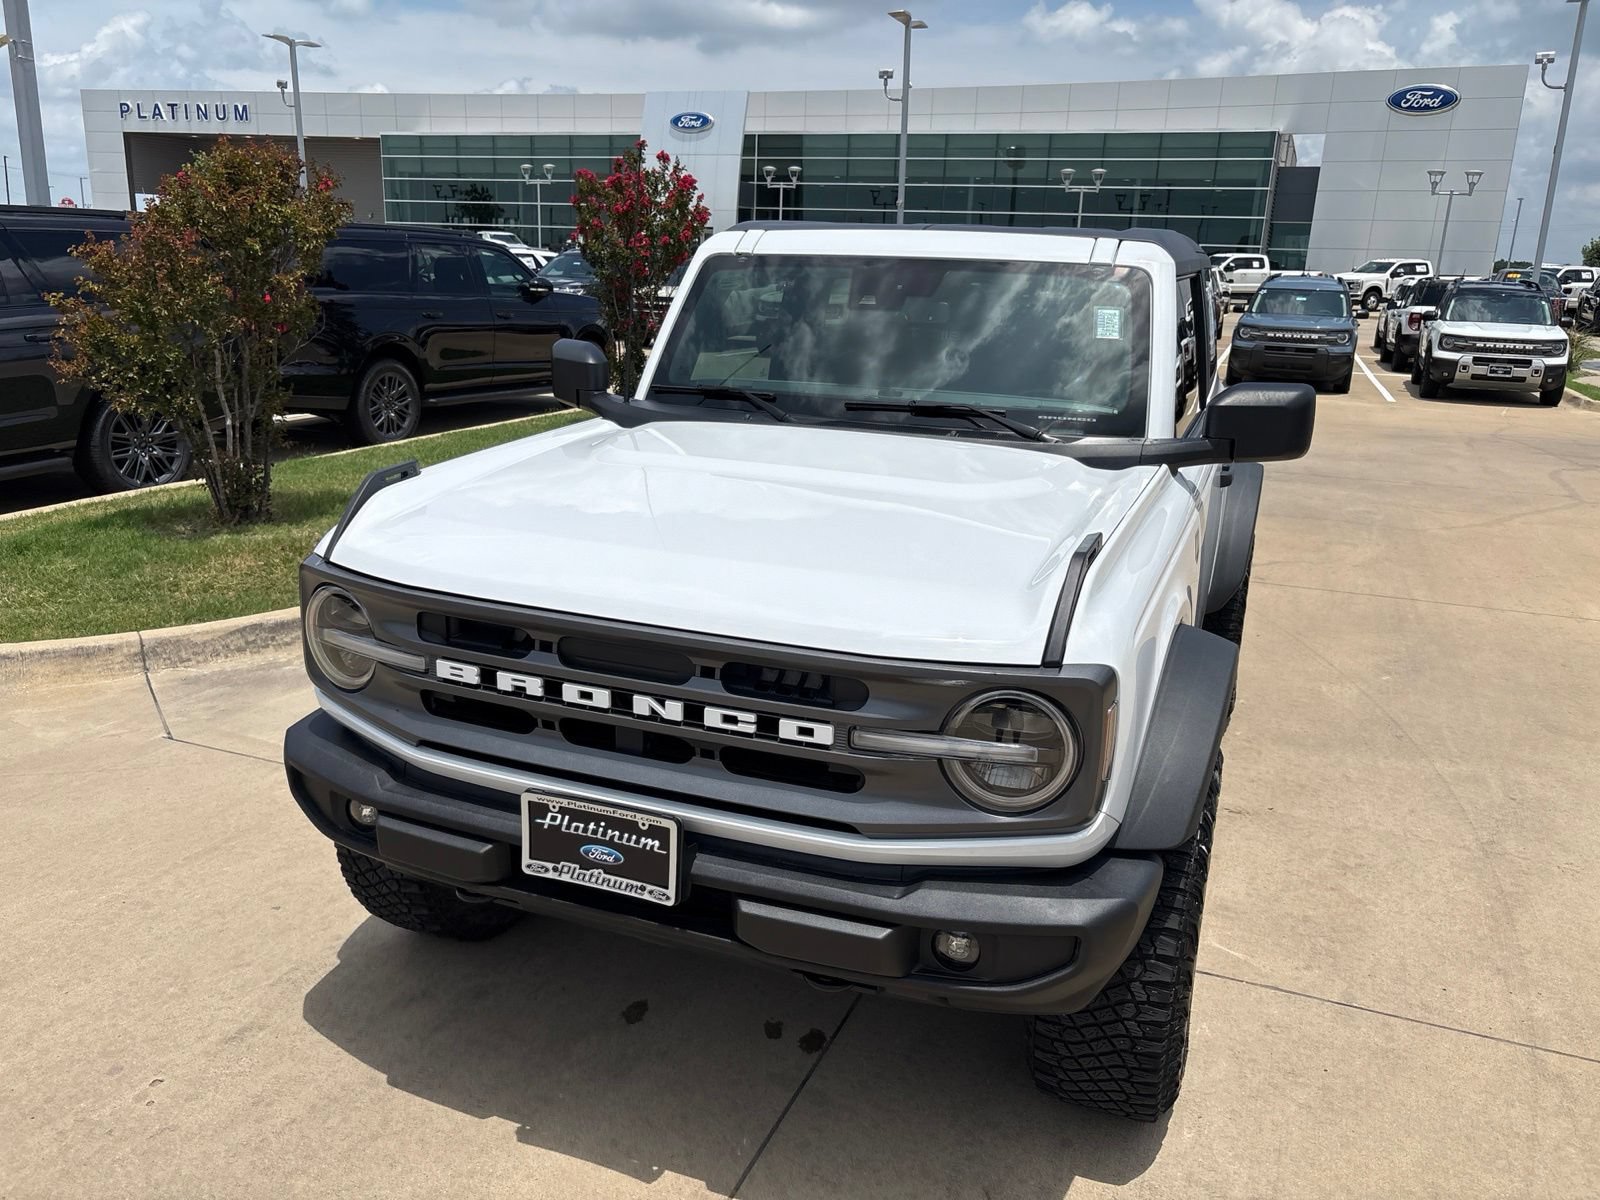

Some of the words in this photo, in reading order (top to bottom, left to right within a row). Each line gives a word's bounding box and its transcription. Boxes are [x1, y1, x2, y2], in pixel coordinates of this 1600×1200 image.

[1400, 90, 1444, 108] Ford
[119, 102, 249, 121] PLATINUM
[677, 115, 703, 127] Ford
[435, 658, 835, 747] BRONCO
[536, 796, 663, 825] www.PlatinumFord.com
[534, 812, 668, 855] Platinum
[588, 847, 616, 864] Ford
[557, 863, 646, 897] Platinum
